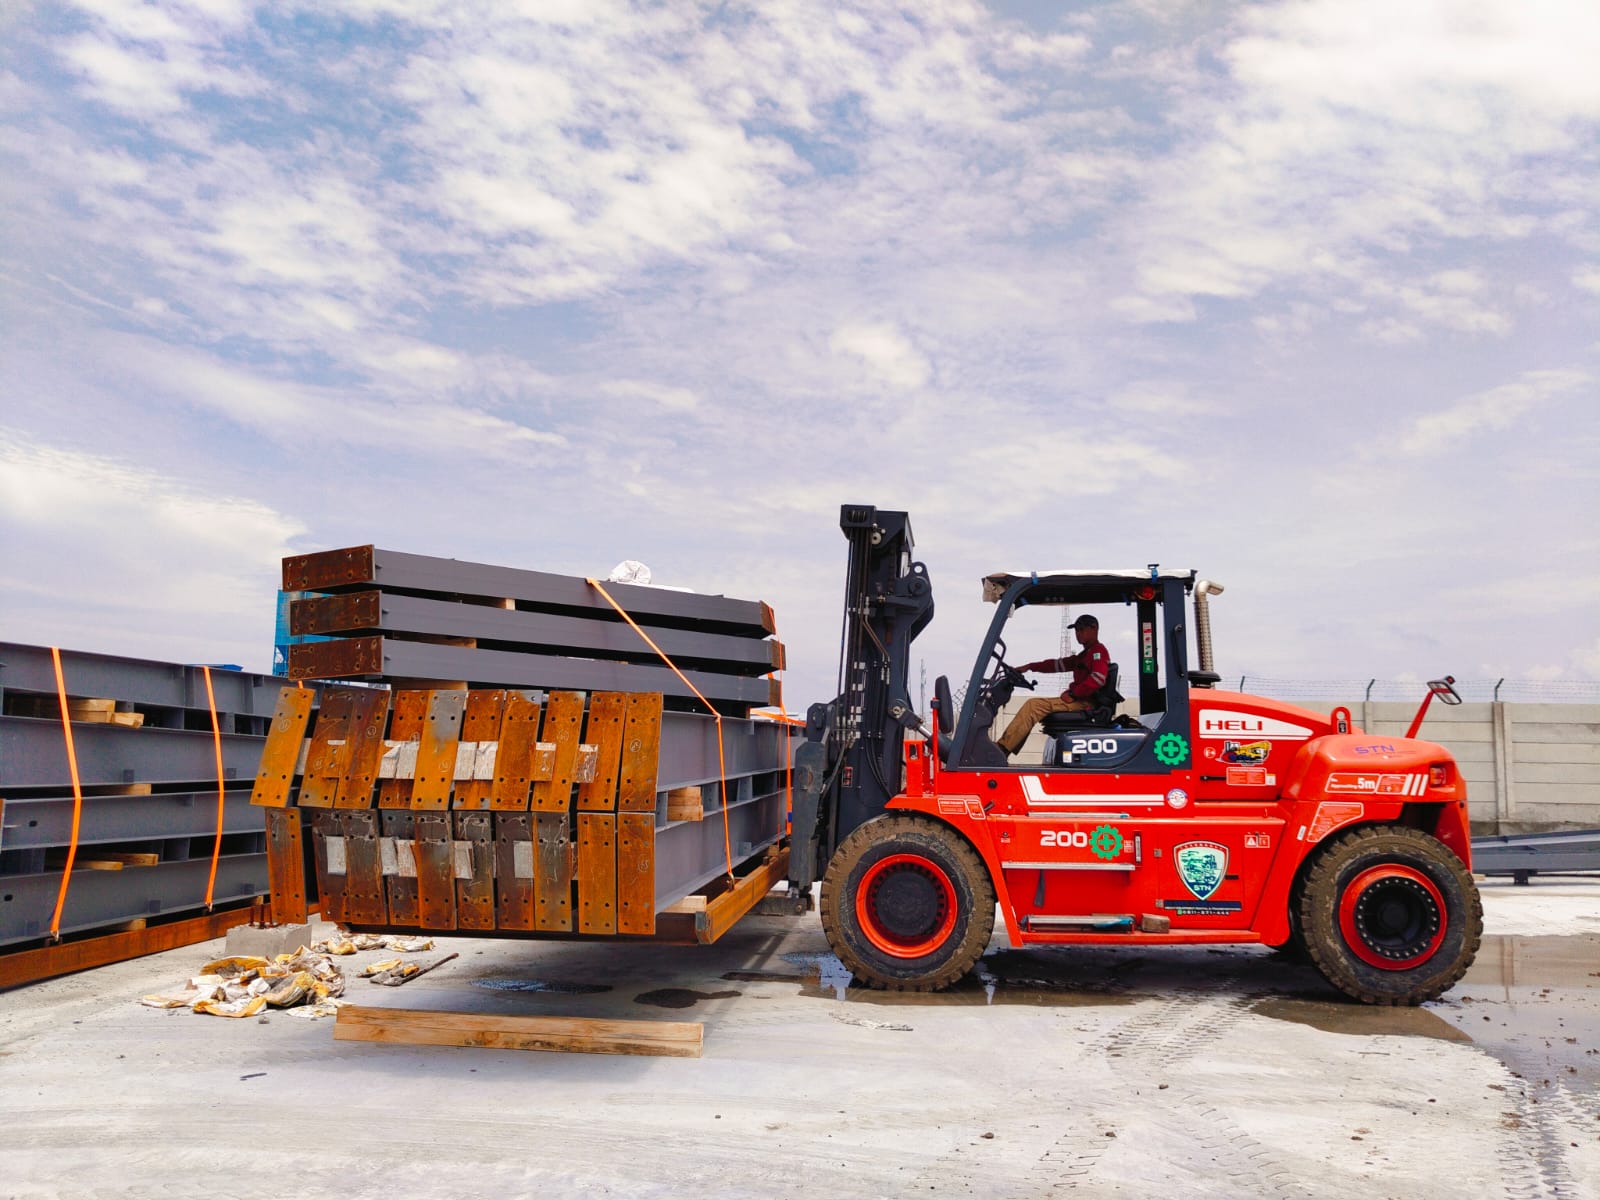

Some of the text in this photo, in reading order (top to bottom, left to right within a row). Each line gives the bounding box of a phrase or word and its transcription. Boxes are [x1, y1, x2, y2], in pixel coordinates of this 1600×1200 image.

[1205, 719, 1264, 731] HELI
[1071, 738, 1118, 754] 200
[1355, 743, 1396, 755] STN
[1357, 777, 1376, 789] 5m
[1040, 830, 1088, 847] 200
